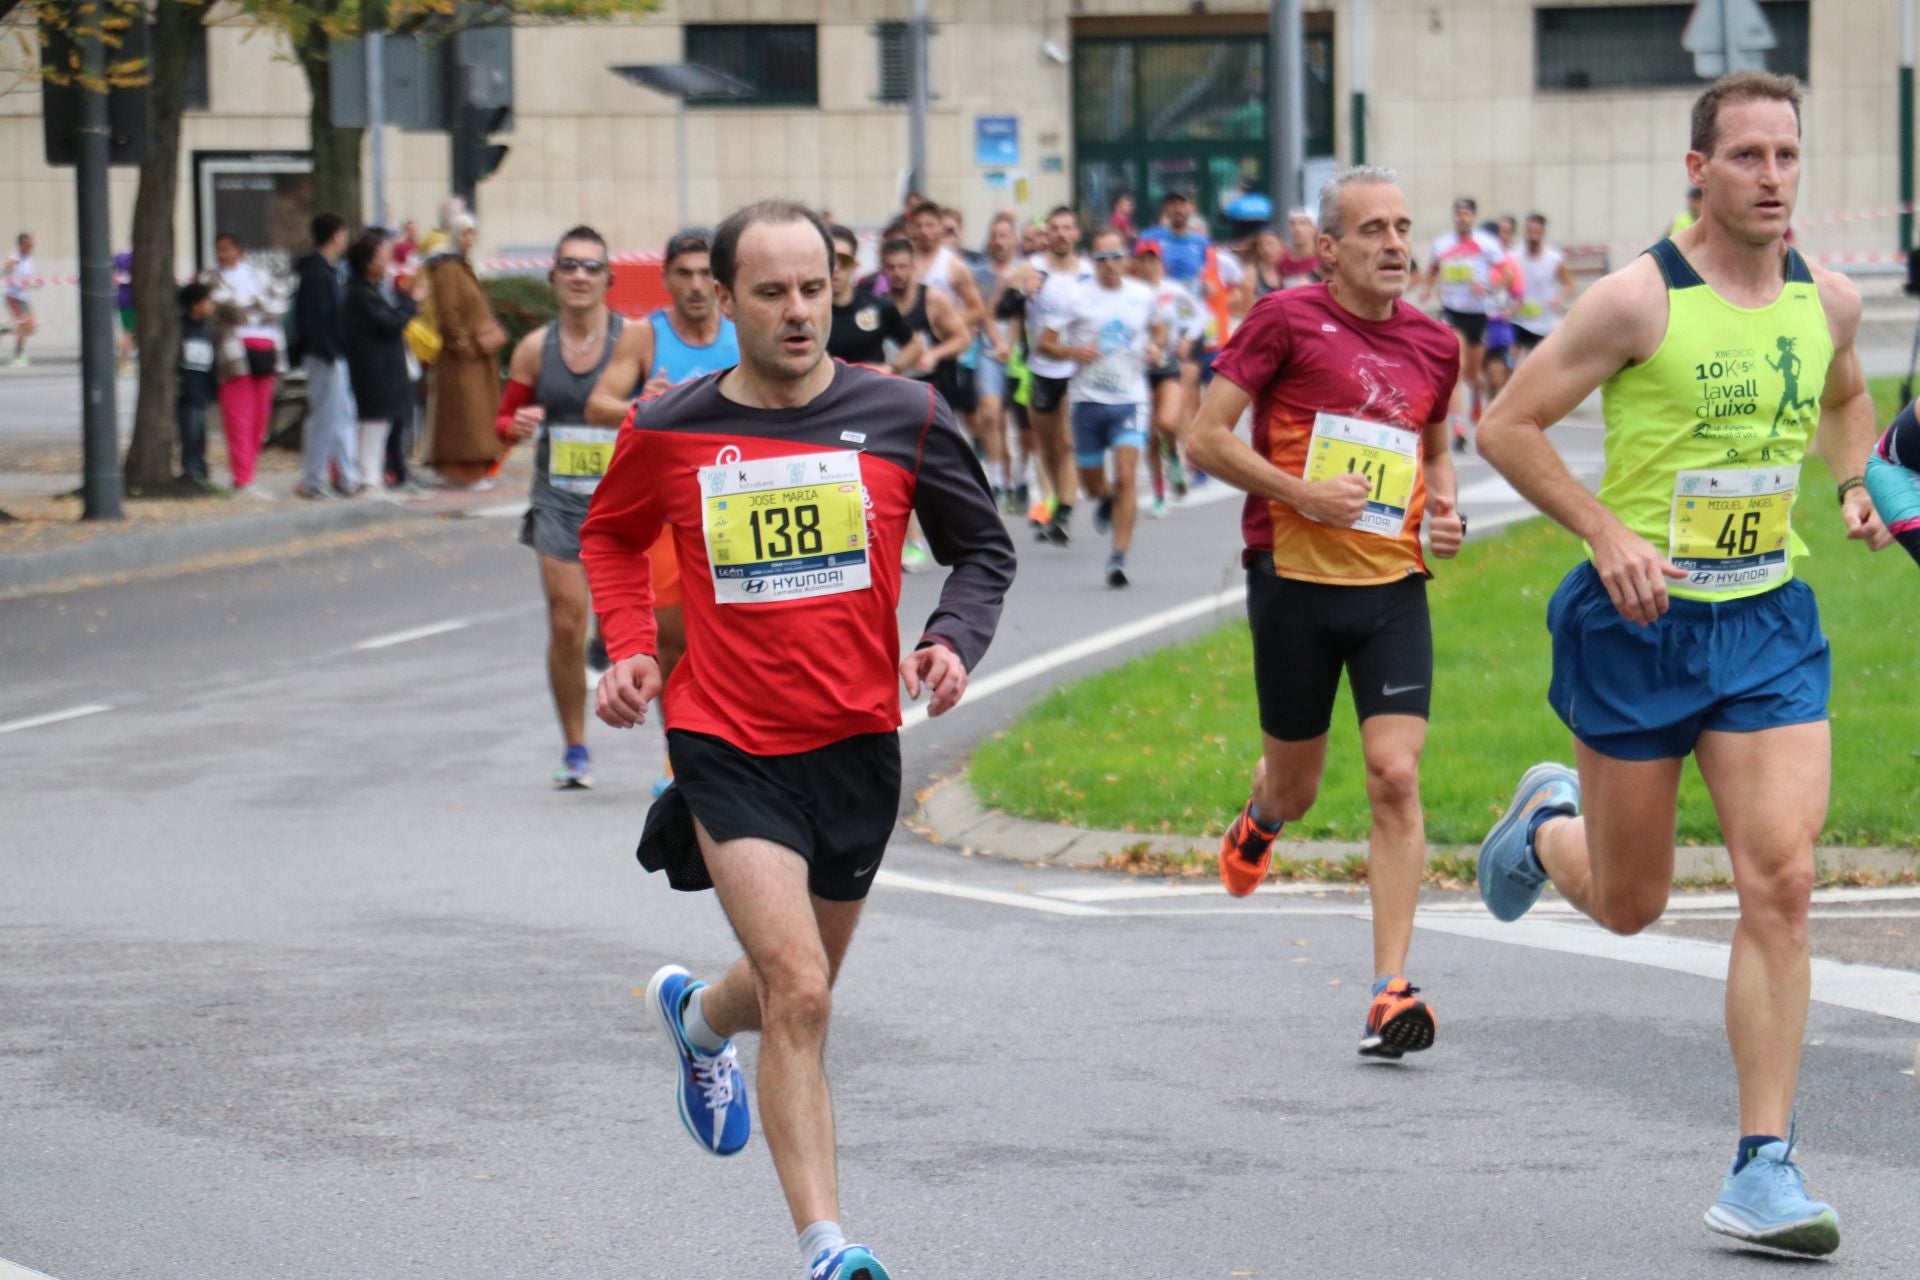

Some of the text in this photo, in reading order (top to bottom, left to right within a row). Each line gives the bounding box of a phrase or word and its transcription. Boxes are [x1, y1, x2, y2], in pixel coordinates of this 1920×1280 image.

[819, 462, 828, 473] k
[739, 470, 747, 482] k
[1710, 478, 1718, 488] k
[1775, 474, 1781, 484] k
[749, 490, 818, 507] JOSE MARIA
[1708, 500, 1744, 510] MIGUEL
[1360, 511, 1391, 527] UNDAI
[749, 504, 823, 560] 138
[1715, 512, 1761, 557] 46
[772, 570, 843, 590] HYUNDAI
[1716, 568, 1769, 583] HYUNDAI
